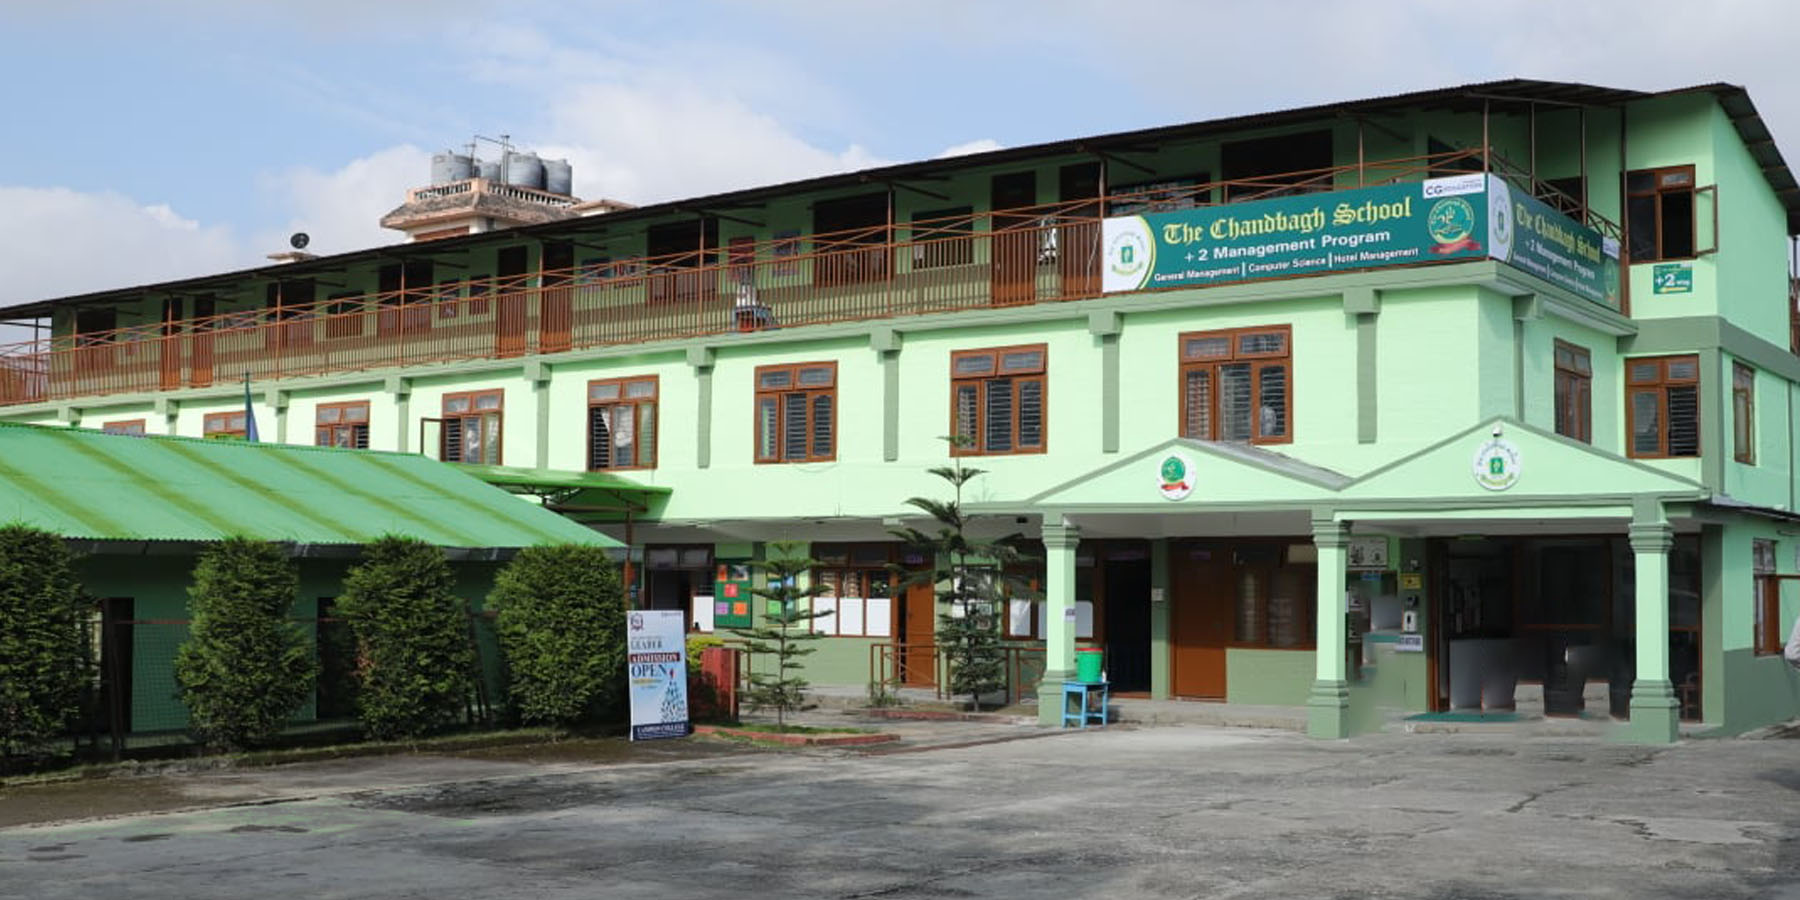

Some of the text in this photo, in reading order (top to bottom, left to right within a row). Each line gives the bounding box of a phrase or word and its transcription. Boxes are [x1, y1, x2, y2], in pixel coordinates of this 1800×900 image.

[1425, 185, 1443, 195] CG
[1162, 222, 1204, 246] The
[1209, 206, 1325, 242] Chandbagh
[1332, 195, 1413, 226] School
[1213, 238, 1316, 260] Management
[1321, 231, 1391, 248] Program
[1334, 247, 1419, 264] Hotel Management
[1248, 256, 1326, 273] Computer Science
[1154, 265, 1240, 281] General Management
[631, 654, 678, 663] ADMISSION
[631, 663, 668, 678] OPEN
